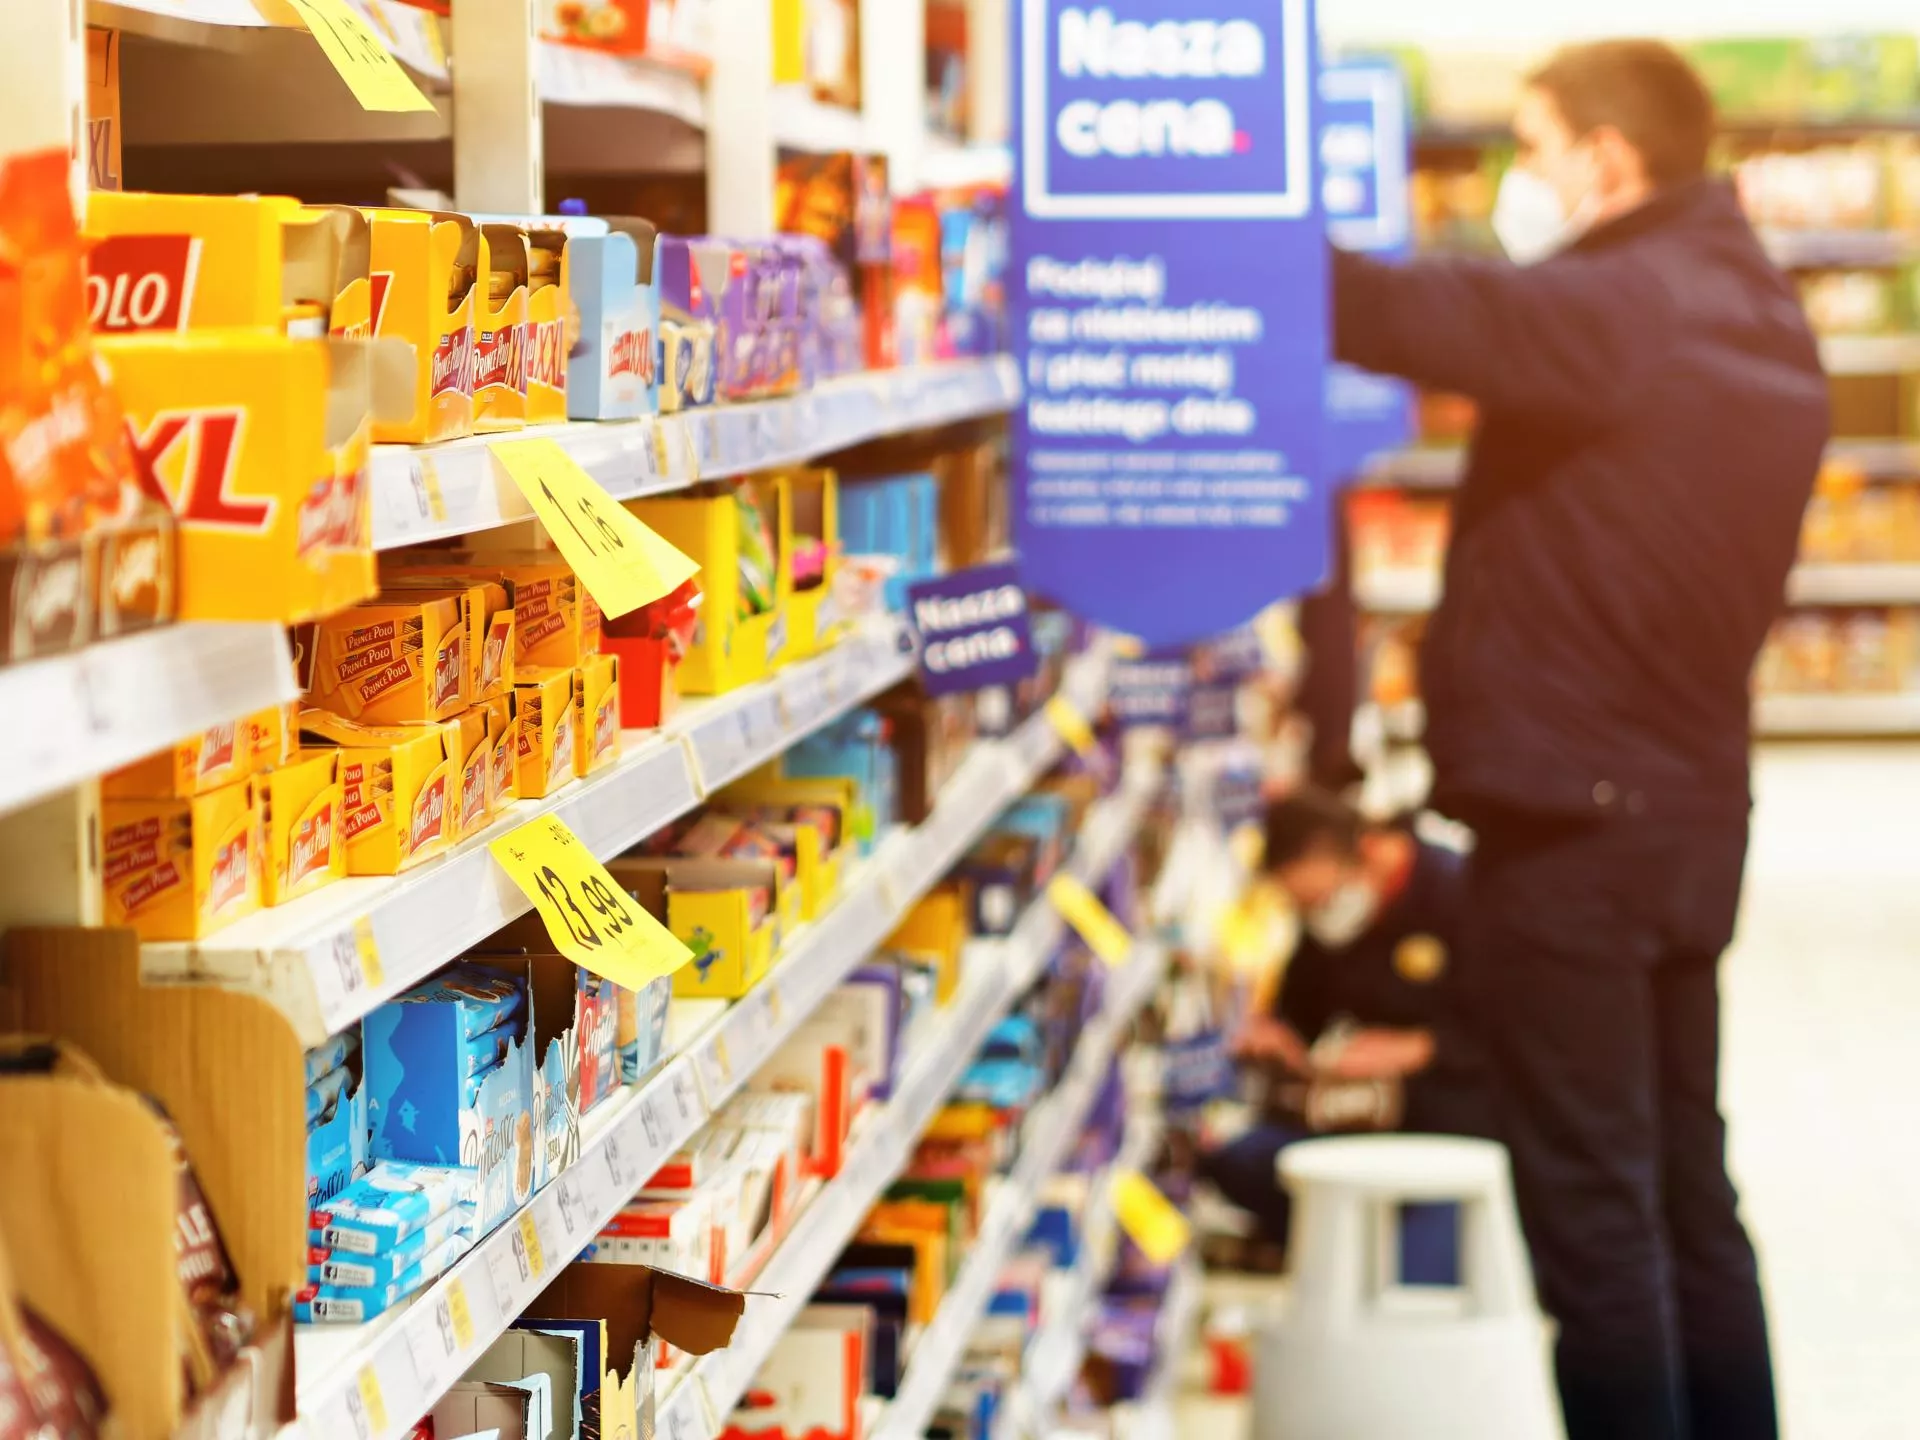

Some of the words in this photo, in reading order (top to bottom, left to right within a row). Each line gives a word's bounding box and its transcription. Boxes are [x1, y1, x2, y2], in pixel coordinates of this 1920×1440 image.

[1058, 7, 1265, 79] Nasza
[1170, 393, 1256, 435] dnia
[914, 584, 1026, 634] Nasza
[349, 632, 372, 649] PRINCE
[373, 625, 393, 639] POLO
[341, 657, 368, 677] PRINCE
[369, 647, 390, 663] POLO
[362, 677, 388, 699] PRINCE
[386, 664, 408, 682] POLO
[354, 808, 377, 827] POLO
[534, 866, 633, 951] 13,99
